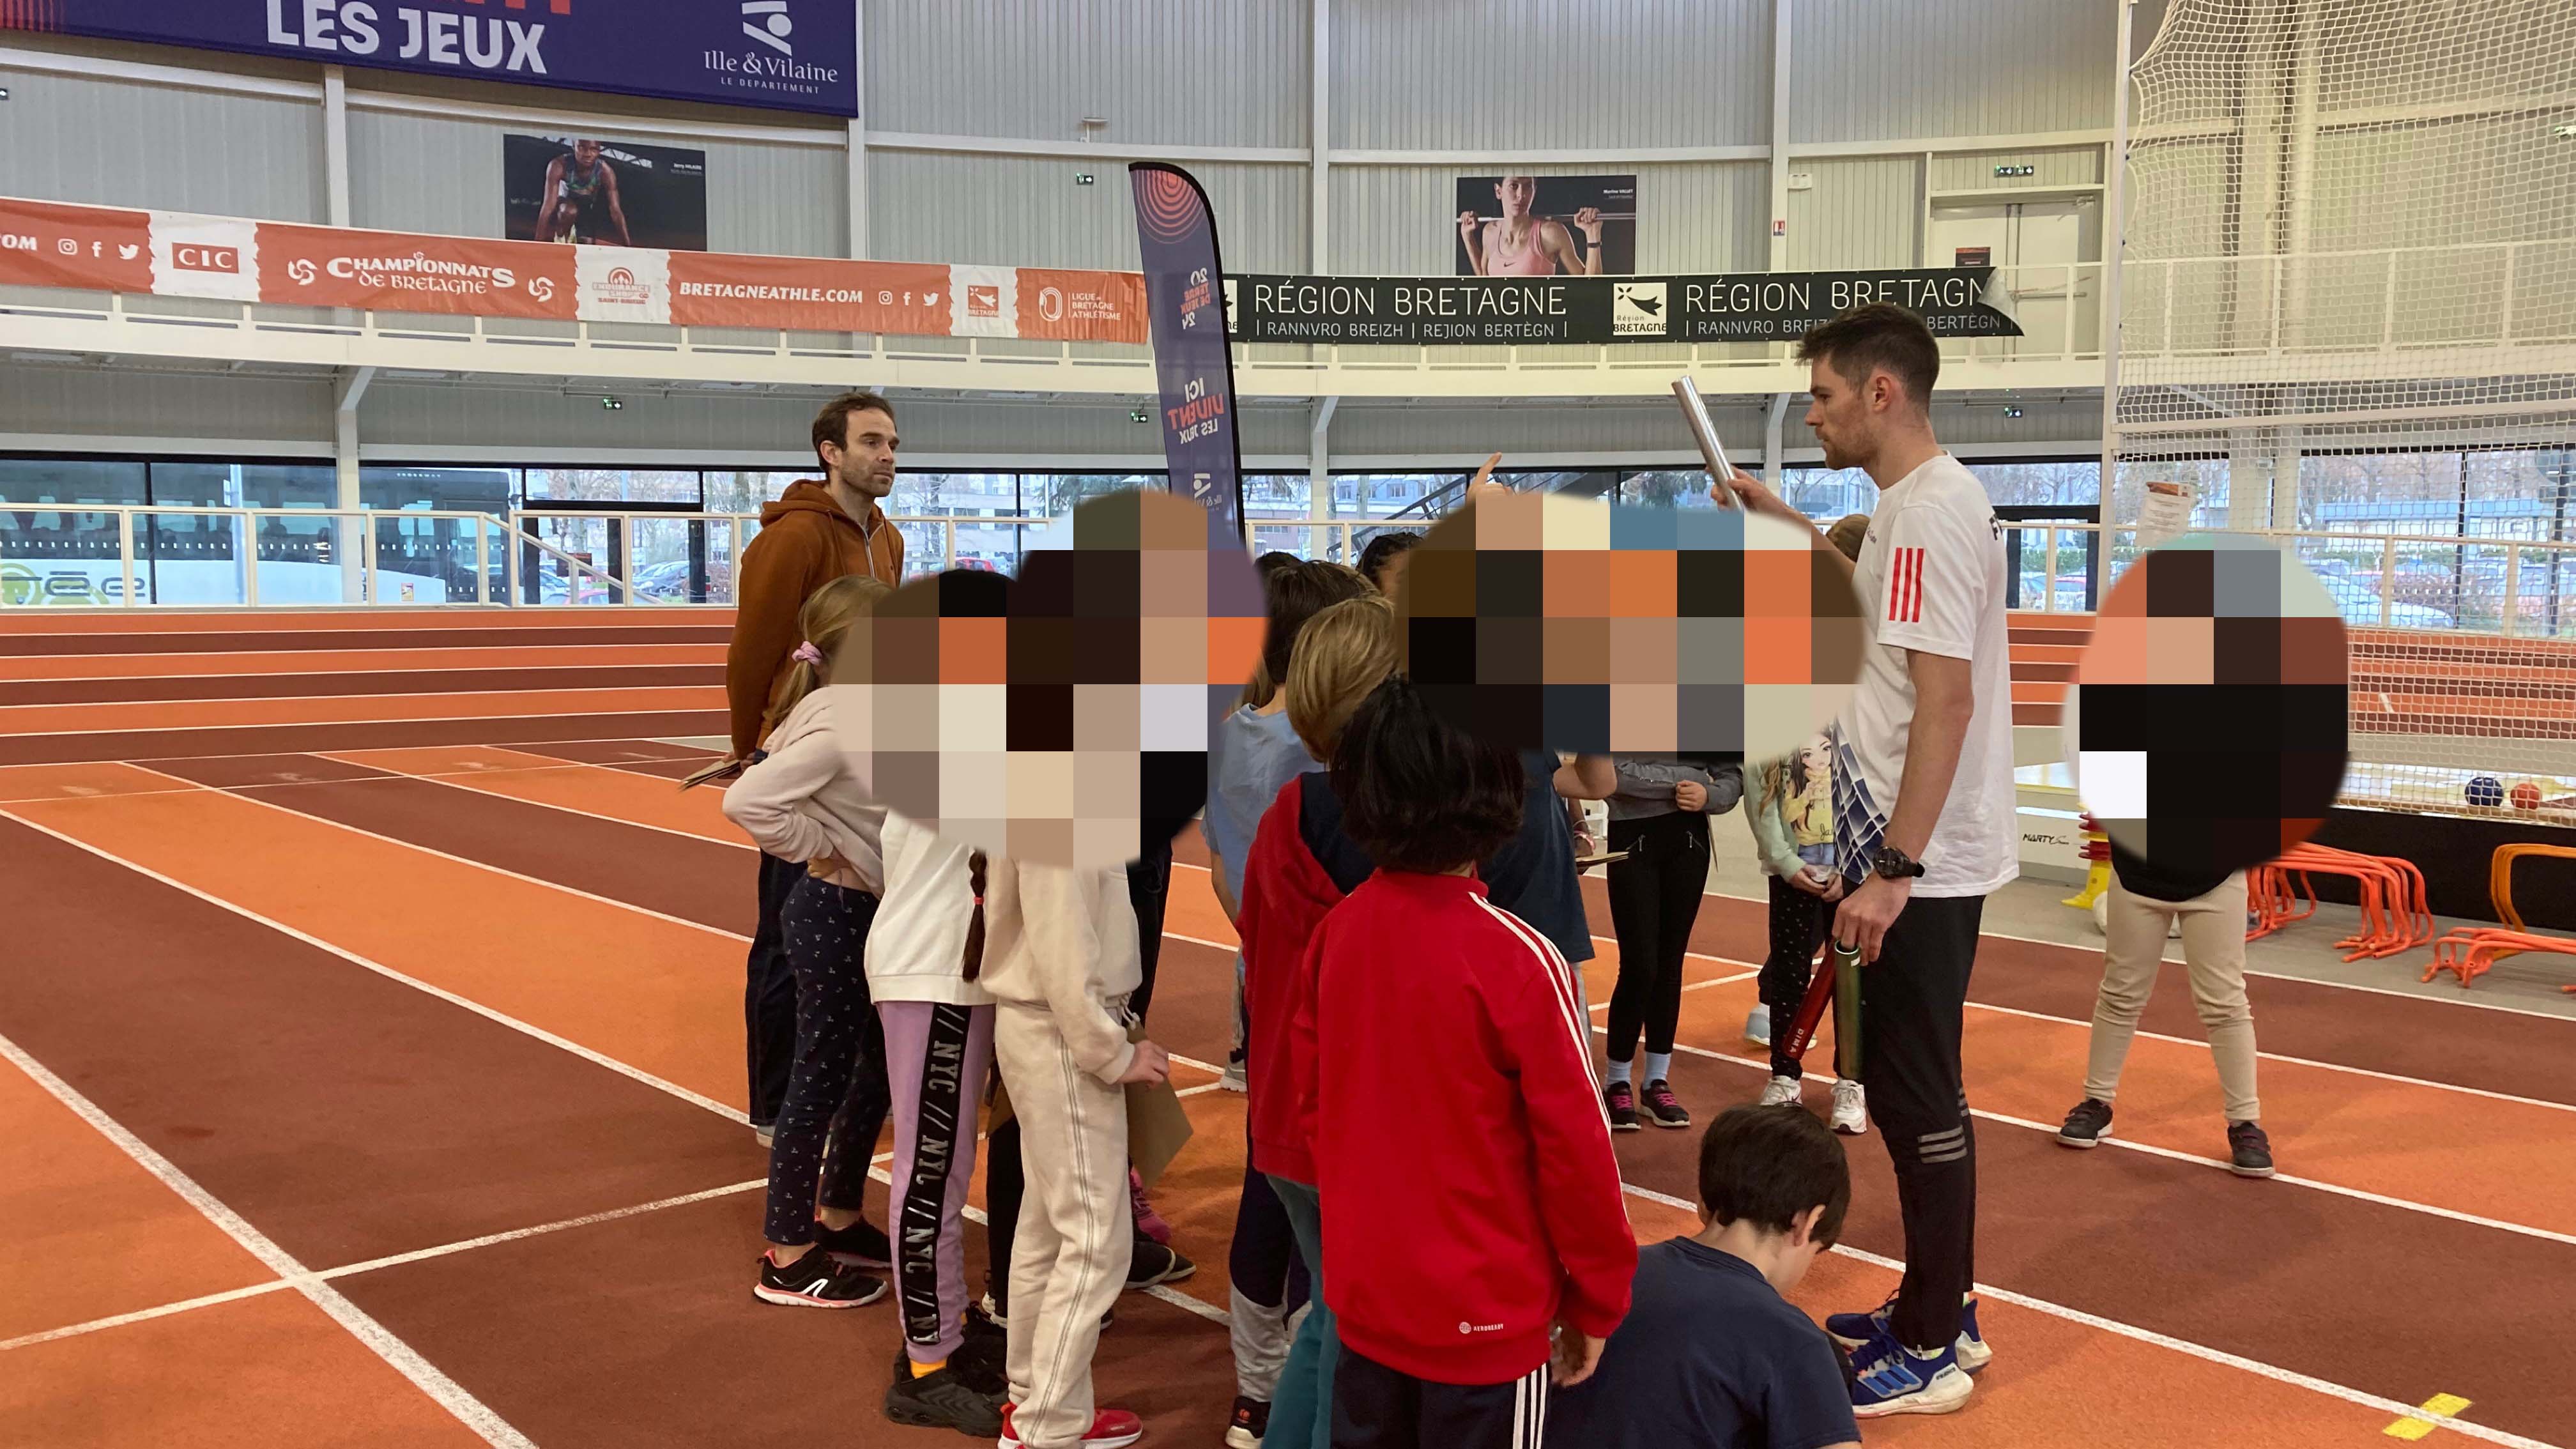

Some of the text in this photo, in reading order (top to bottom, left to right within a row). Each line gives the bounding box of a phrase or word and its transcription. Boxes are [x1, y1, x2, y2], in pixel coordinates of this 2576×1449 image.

[267, 0, 548, 75] LES JEUX
[705, 50, 838, 82] Ille & Vilaine
[721, 77, 818, 94] LE DEPARTEMENT
[178, 248, 232, 268] CIC
[326, 251, 516, 288] CHAMPIONNATS
[679, 282, 862, 303] BRETAGNEATHLE.COM
[1072, 293, 1095, 301] LIGUE
[1255, 281, 1567, 316] RÉGION BRETAGNE
[1686, 279, 1810, 313] RÉGION
[1072, 302, 1114, 310] BRETAGNE
[1072, 310, 1121, 321] ATHLÉTISME
[1268, 320, 1555, 339] RANNVRO BREIZH REJION BERTÈGN
[1613, 323, 1667, 332] BRETAGNE
[1698, 320, 1774, 335] RANNVRO
[1927, 313, 2000, 330] BERTÈGN
[1789, 1028, 1805, 1053] DIMA
[928, 1040, 962, 1094] NYC
[905, 1227, 935, 1274] NYC
